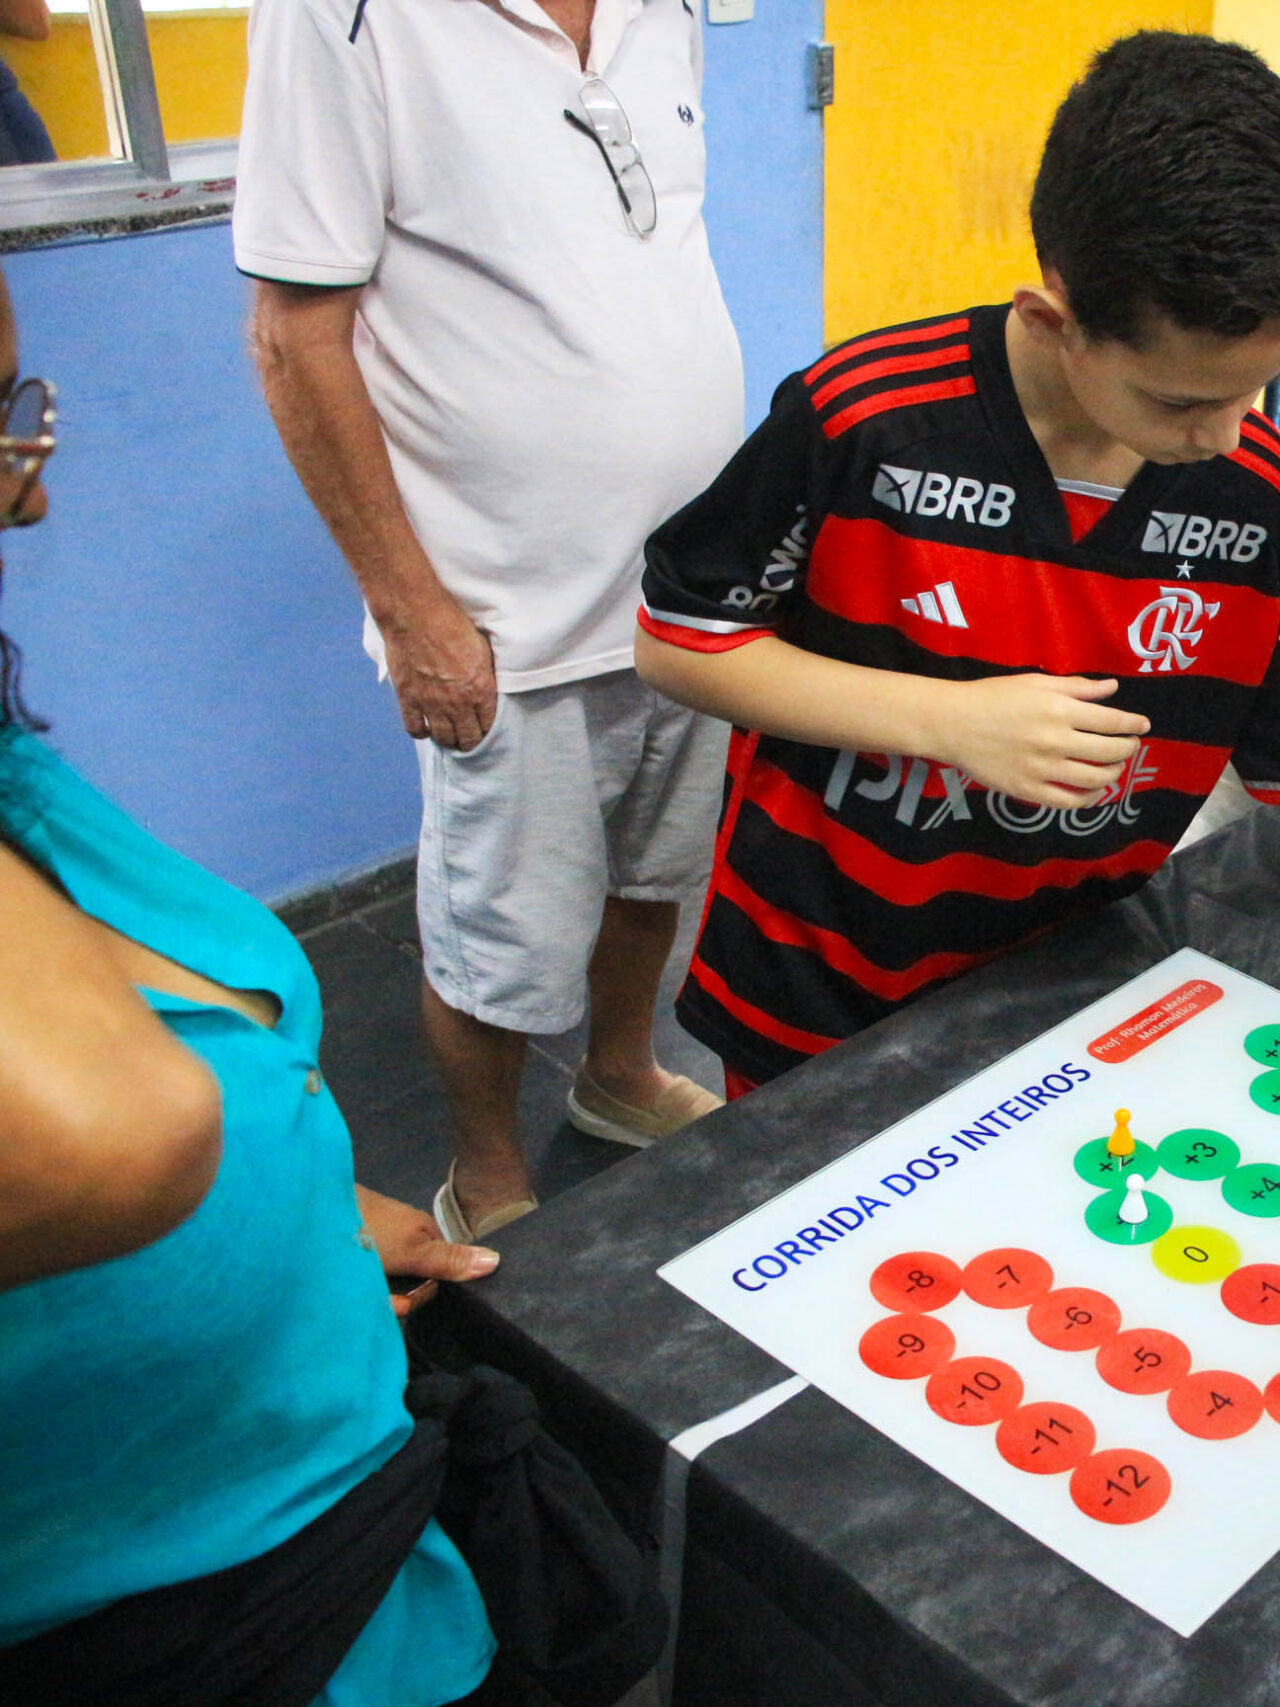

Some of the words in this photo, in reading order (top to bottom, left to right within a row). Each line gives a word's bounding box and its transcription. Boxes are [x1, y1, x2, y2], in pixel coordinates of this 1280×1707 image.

[916, 472, 1016, 527] BRB
[1177, 515, 1268, 563] BRB
[1160, 982, 1207, 1013] Medeiros
[1136, 1002, 1199, 1042] Matemática
[1184, 1142, 1218, 1164] +3
[732, 1194, 891, 1292] CORRIDA
[879, 1145, 959, 1198] DOS
[951, 1062, 1091, 1152] INTEIROS
[1183, 1246, 1209, 1263] 0
[907, 1270, 936, 1293] -8
[996, 1264, 1020, 1289] -7
[1065, 1306, 1093, 1330] -6
[897, 1334, 925, 1358] -9
[1133, 1347, 1162, 1373] -5
[957, 1371, 1002, 1409] -10
[1207, 1391, 1233, 1416] -4
[1031, 1418, 1073, 1454] -11
[1103, 1464, 1149, 1506] -12
